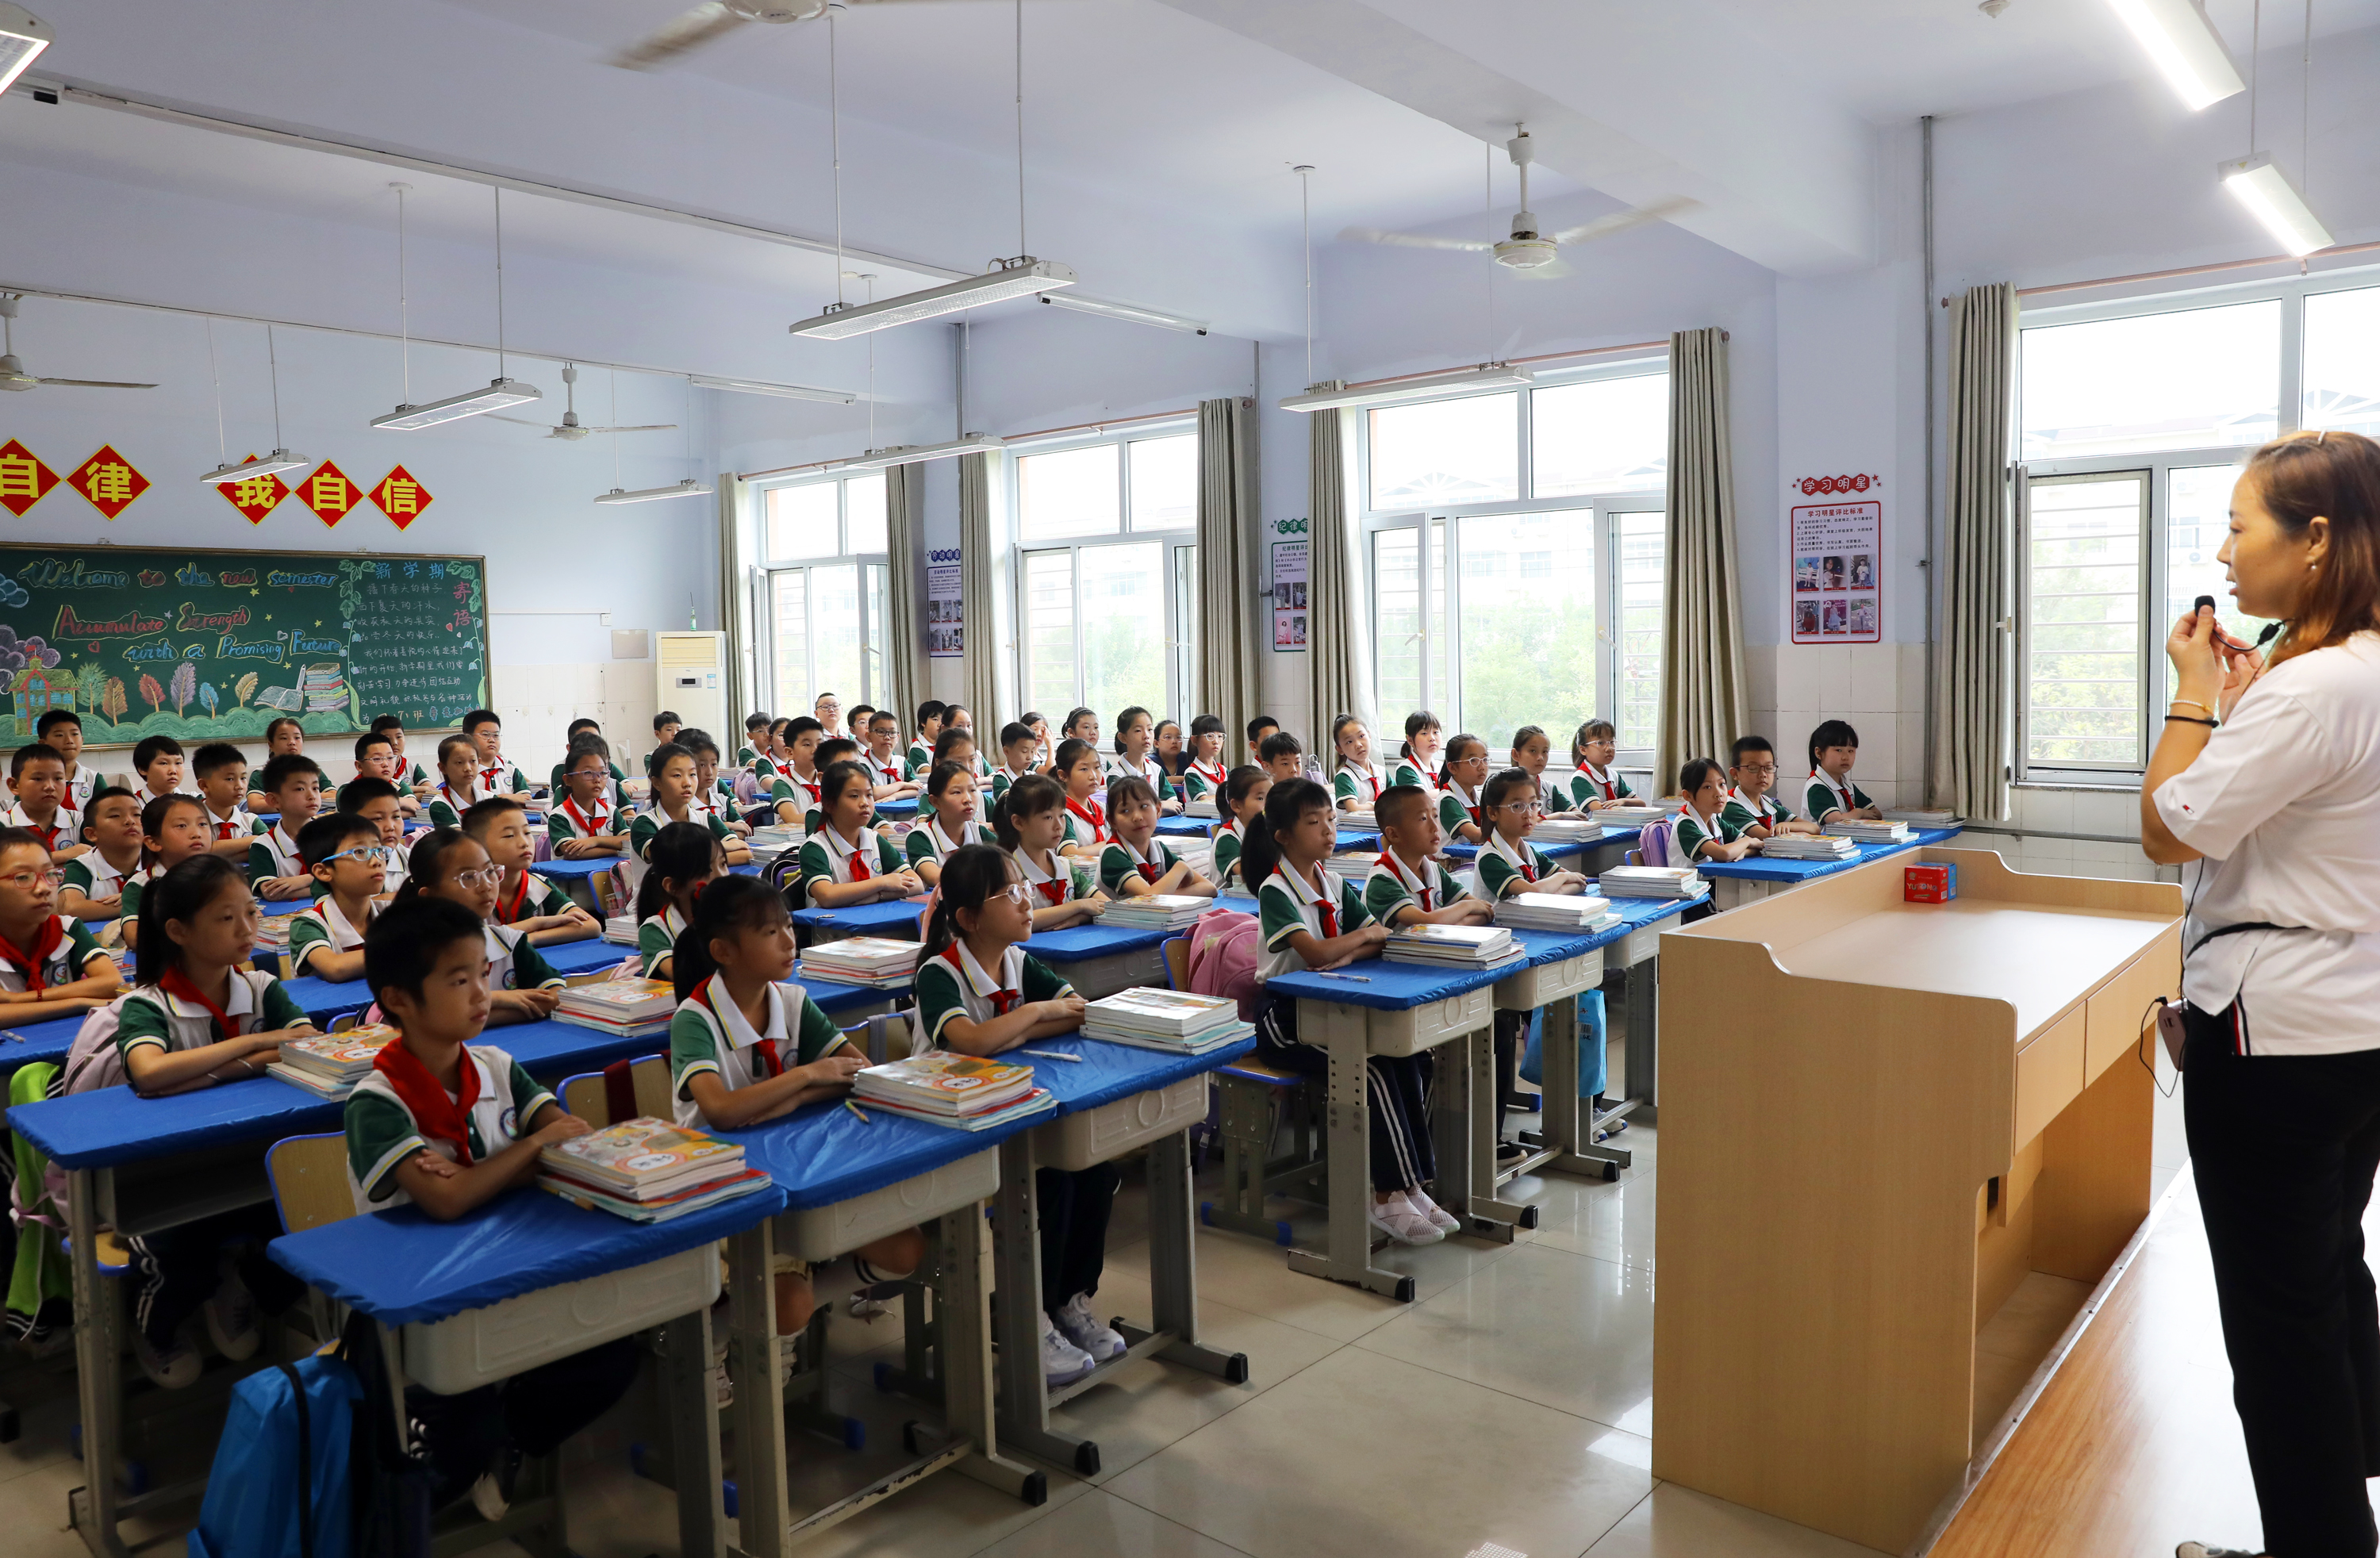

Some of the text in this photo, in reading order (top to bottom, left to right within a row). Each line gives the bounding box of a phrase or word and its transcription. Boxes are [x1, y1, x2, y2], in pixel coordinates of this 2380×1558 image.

[0, 454, 132, 503] 自律
[1803, 476, 1867, 493] 学习明星
[235, 472, 417, 515] 我自信
[1807, 508, 1864, 518] 学习明星评比标准
[18, 559, 338, 588] Welcome to the new semester
[375, 561, 444, 580] 新学期
[453, 581, 472, 627] 寄语
[179, 605, 248, 633] Strength
[128, 631, 341, 662] with a Promising Future
